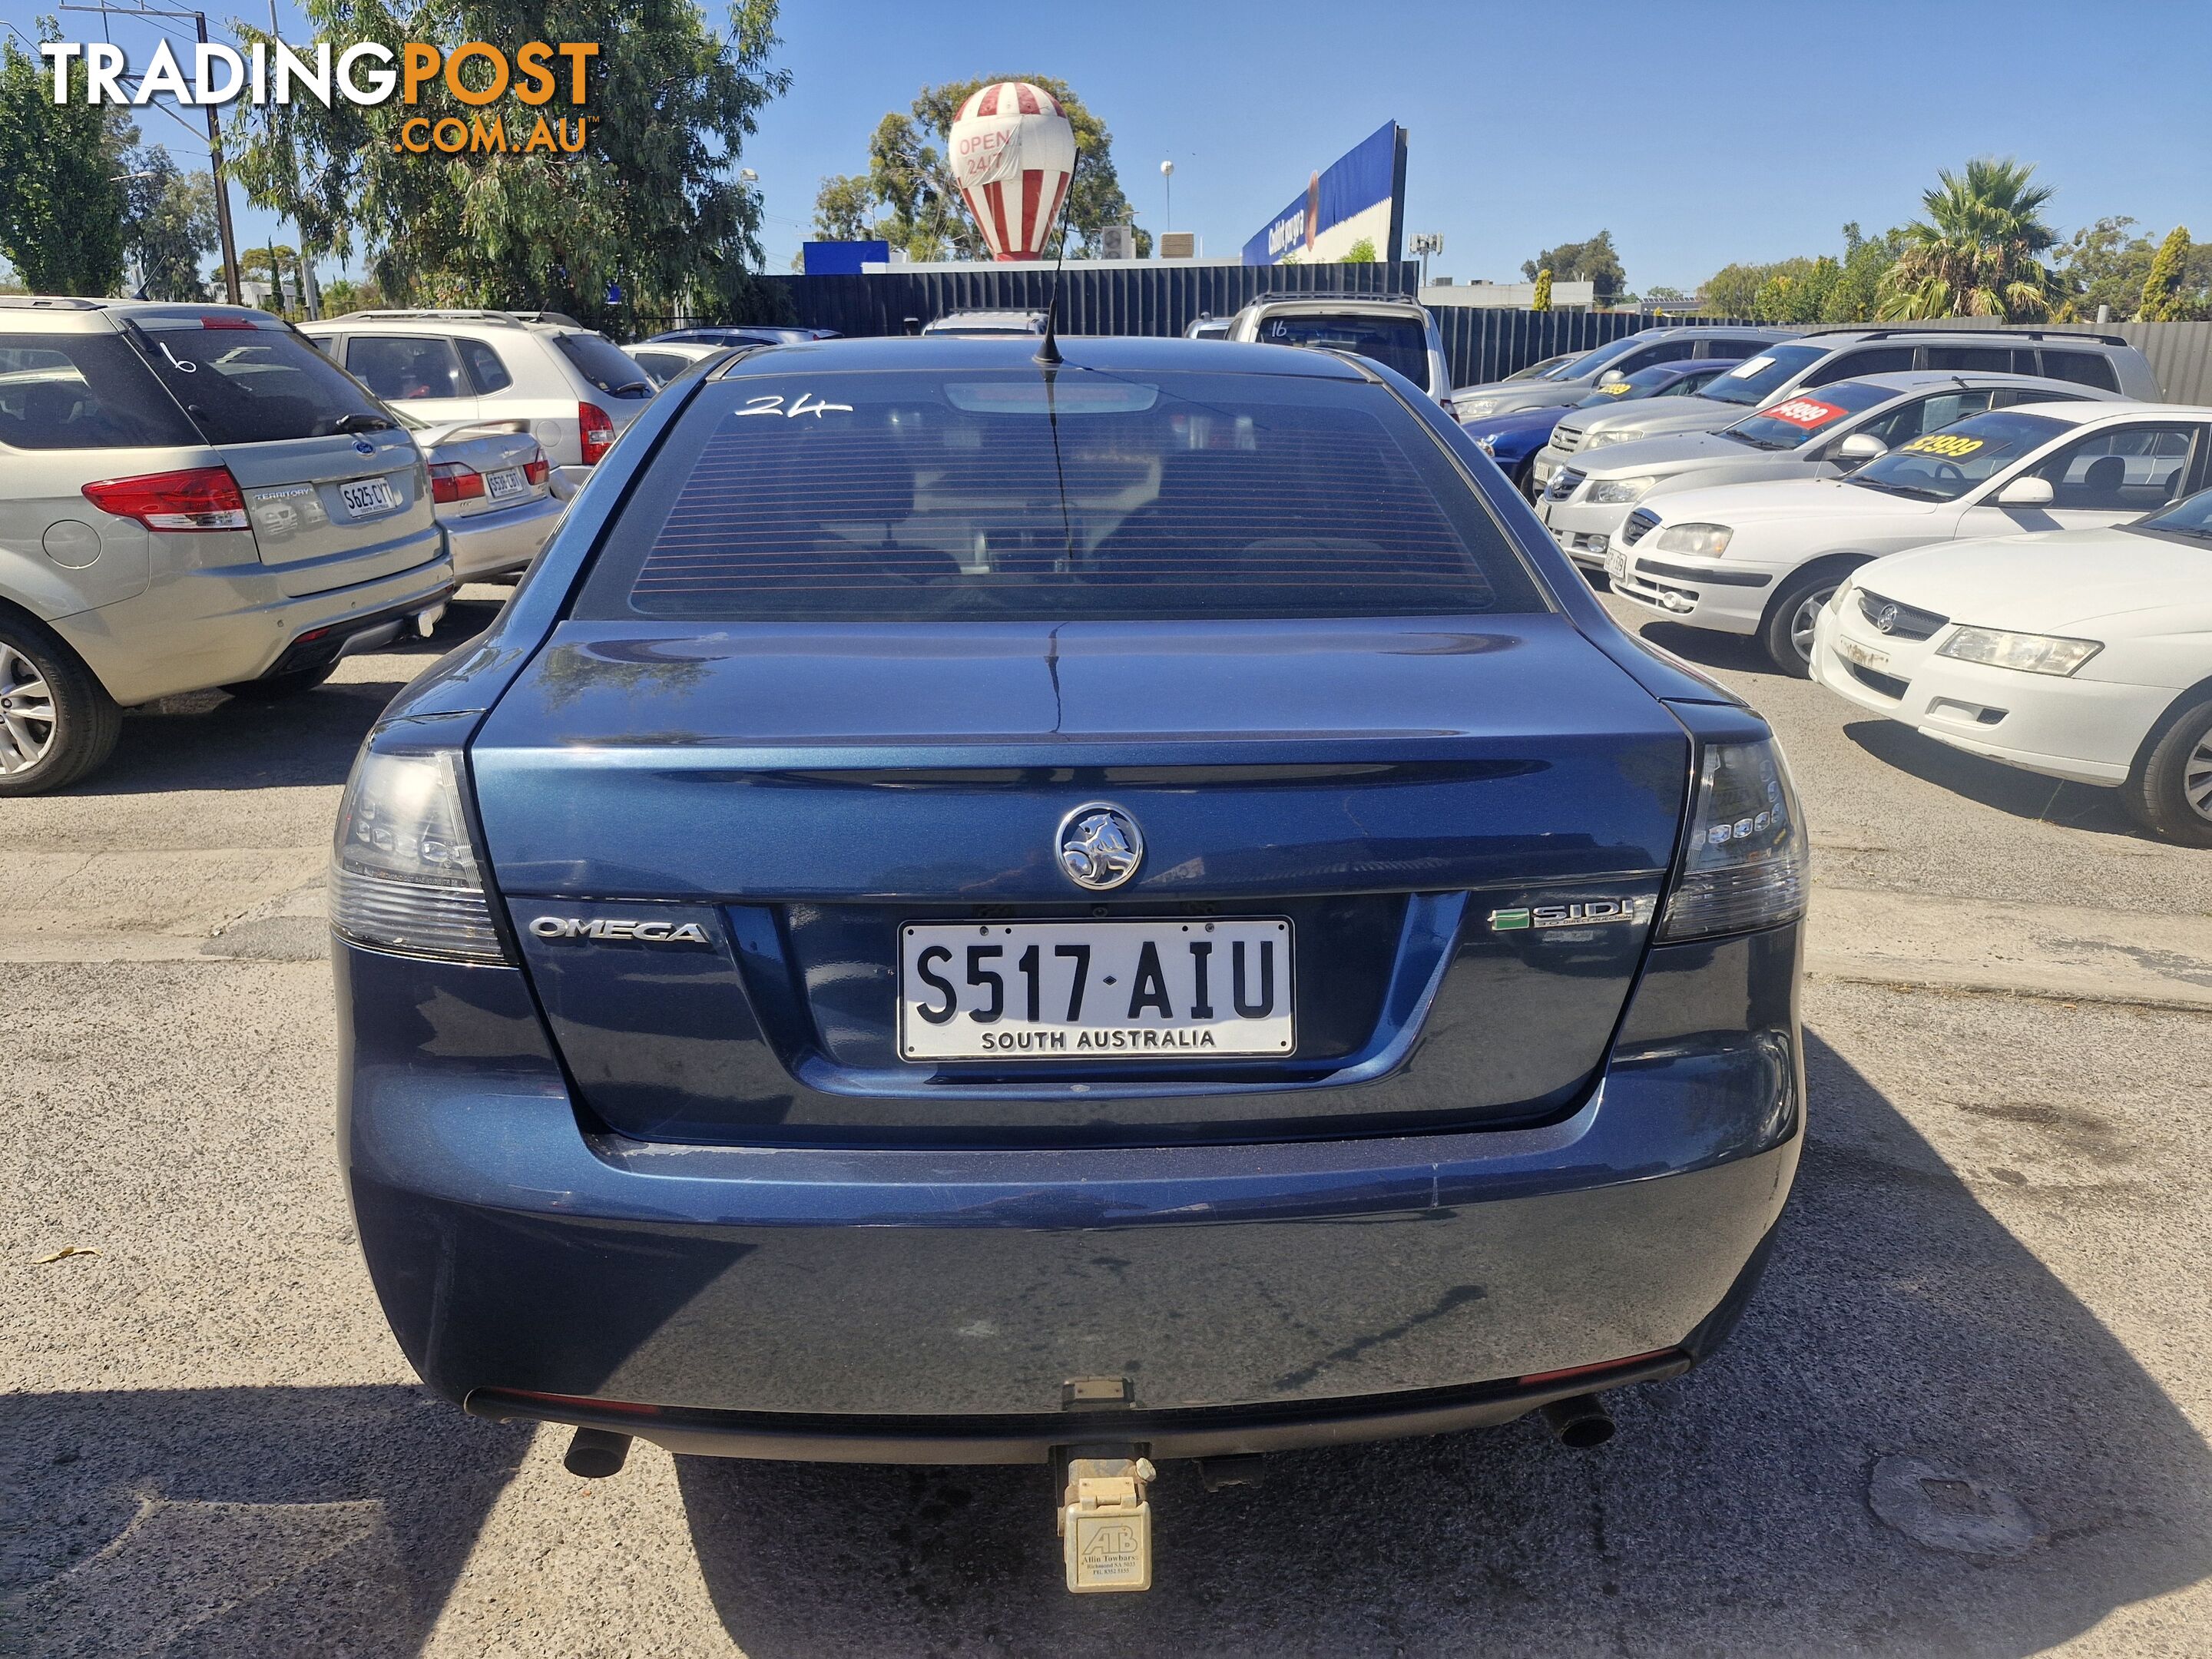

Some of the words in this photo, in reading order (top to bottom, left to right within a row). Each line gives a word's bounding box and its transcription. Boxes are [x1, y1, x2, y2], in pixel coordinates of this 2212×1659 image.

[960, 130, 1010, 155] OPEN
[968, 152, 1002, 175] 24/7
[1272, 320, 1287, 337] 16
[735, 393, 853, 418] 24
[253, 488, 309, 500] TERRITORY
[1533, 899, 1634, 921] SIDI
[528, 916, 710, 943] OMEGA
[981, 1032, 1065, 1050] SOUTH
[1077, 1030, 1216, 1048] AUSTRALIA
